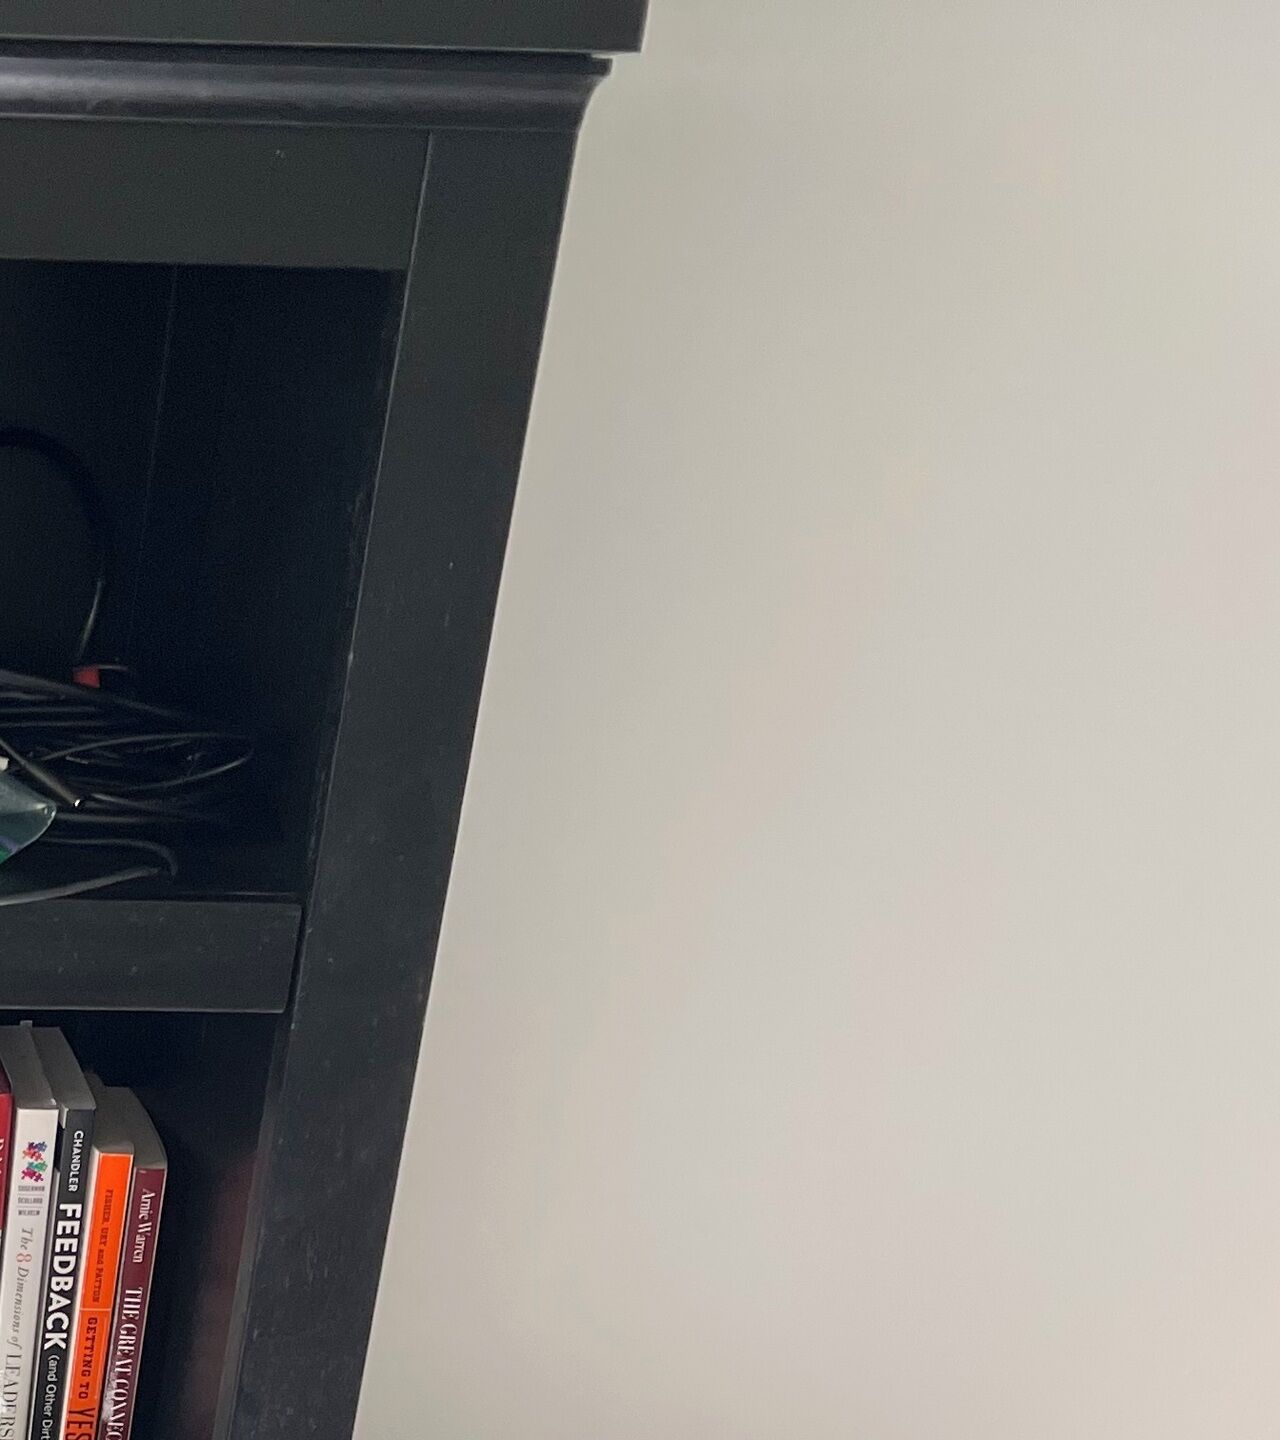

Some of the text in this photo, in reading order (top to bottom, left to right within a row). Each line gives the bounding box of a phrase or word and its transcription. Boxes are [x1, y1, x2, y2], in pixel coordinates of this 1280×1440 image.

[68, 1130, 84, 1193] CHANDLER
[19, 1228, 34, 1250] The
[132, 1220, 153, 1264] Warren
[16, 1252, 33, 1264] 8
[43, 1203, 83, 1350] FEEDBACK
[10, 1265, 30, 1334] Dimensions
[119, 1287, 144, 1321] THE
[6, 1336, 23, 1349] of
[81, 1317, 98, 1377] GETTING
[113, 1323, 137, 1376] GREAT
[48, 1354, 60, 1382] (and
[45, 1383, 58, 1416] Other
[77, 1379, 89, 1400] TO
